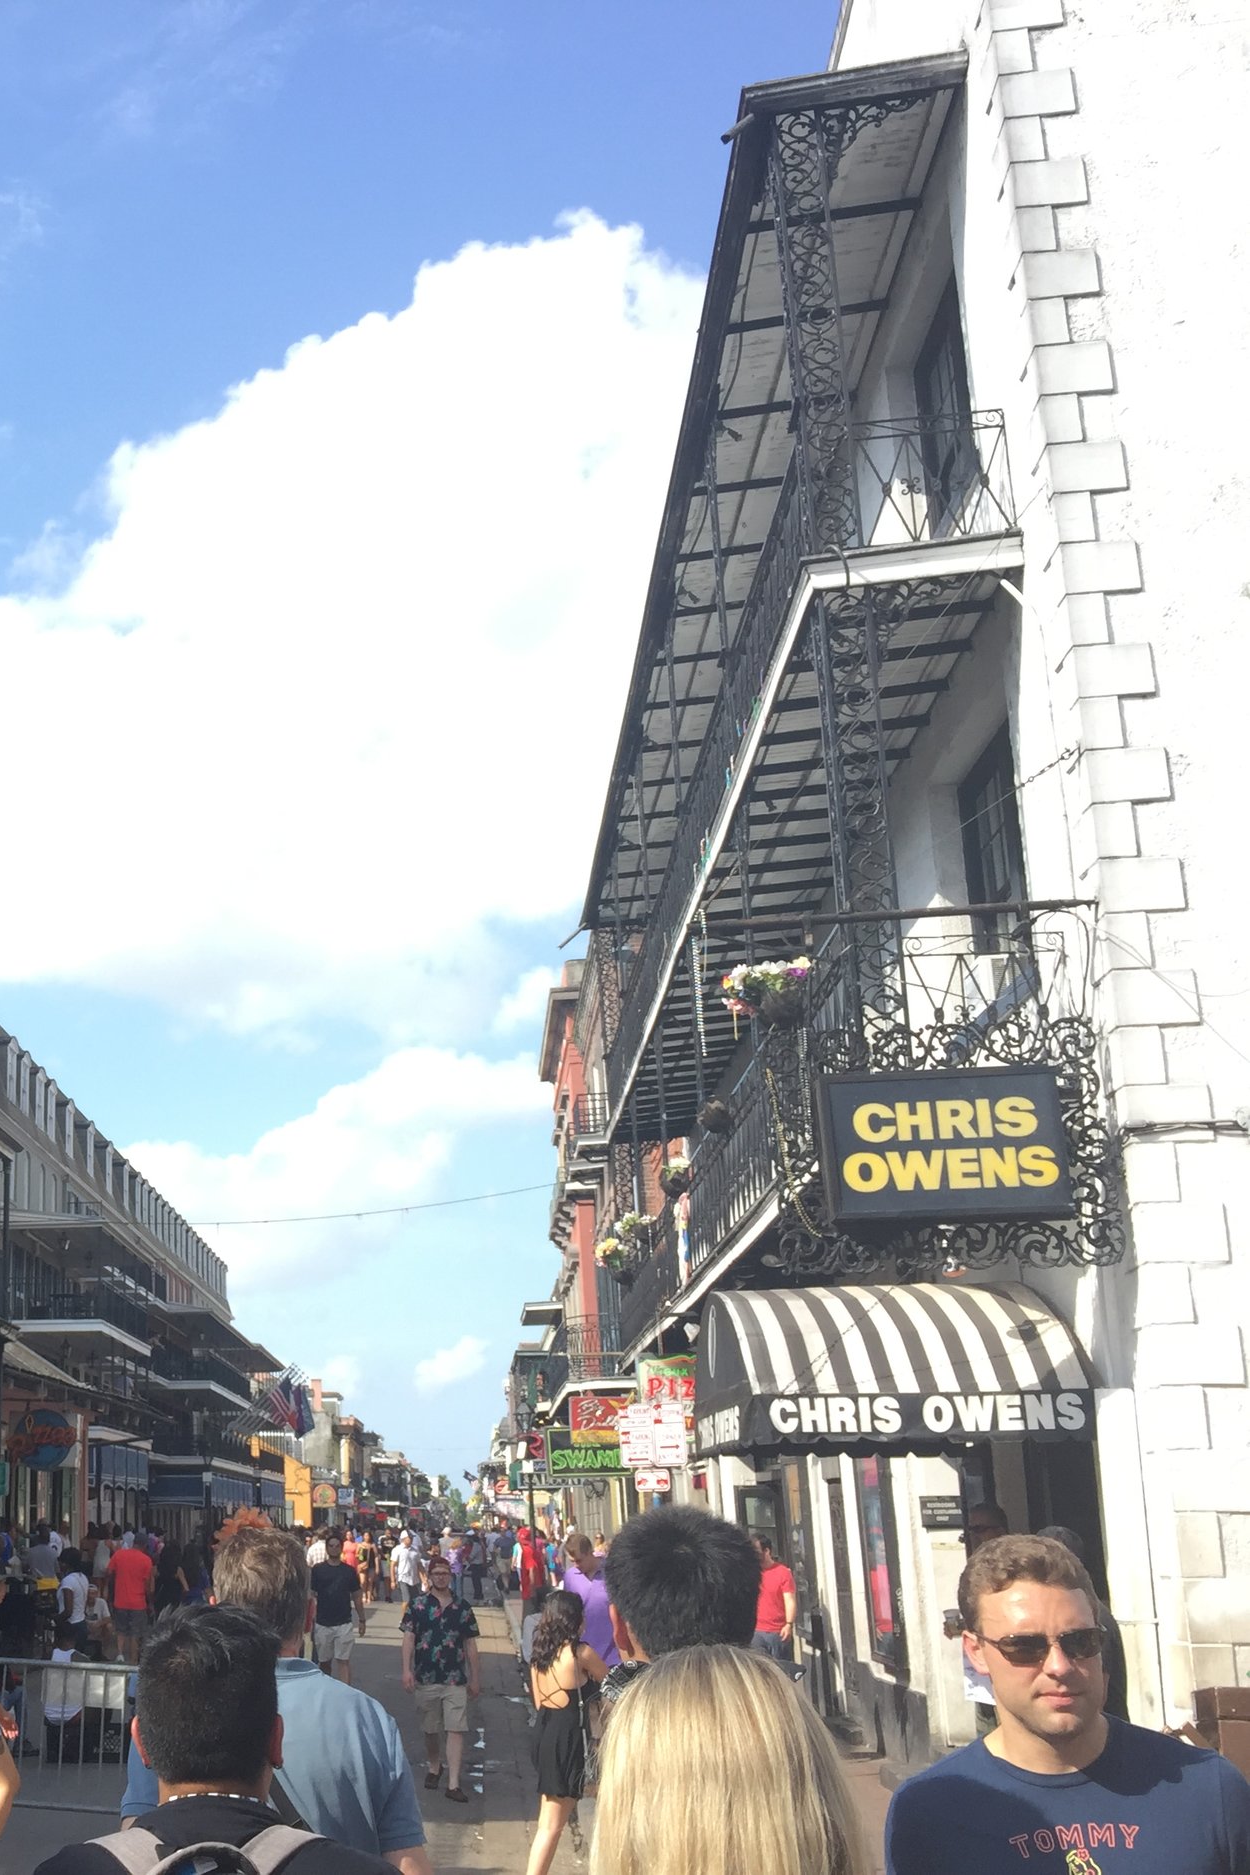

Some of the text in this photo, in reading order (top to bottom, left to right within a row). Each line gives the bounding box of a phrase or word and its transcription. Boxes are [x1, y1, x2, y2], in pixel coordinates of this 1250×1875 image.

[853, 1096, 1039, 1143] CHRIS
[843, 1145, 1060, 1193] OWENS
[769, 1393, 1085, 1433] CHRIS OWENS
[1008, 1822, 1140, 1859] TOMMY
